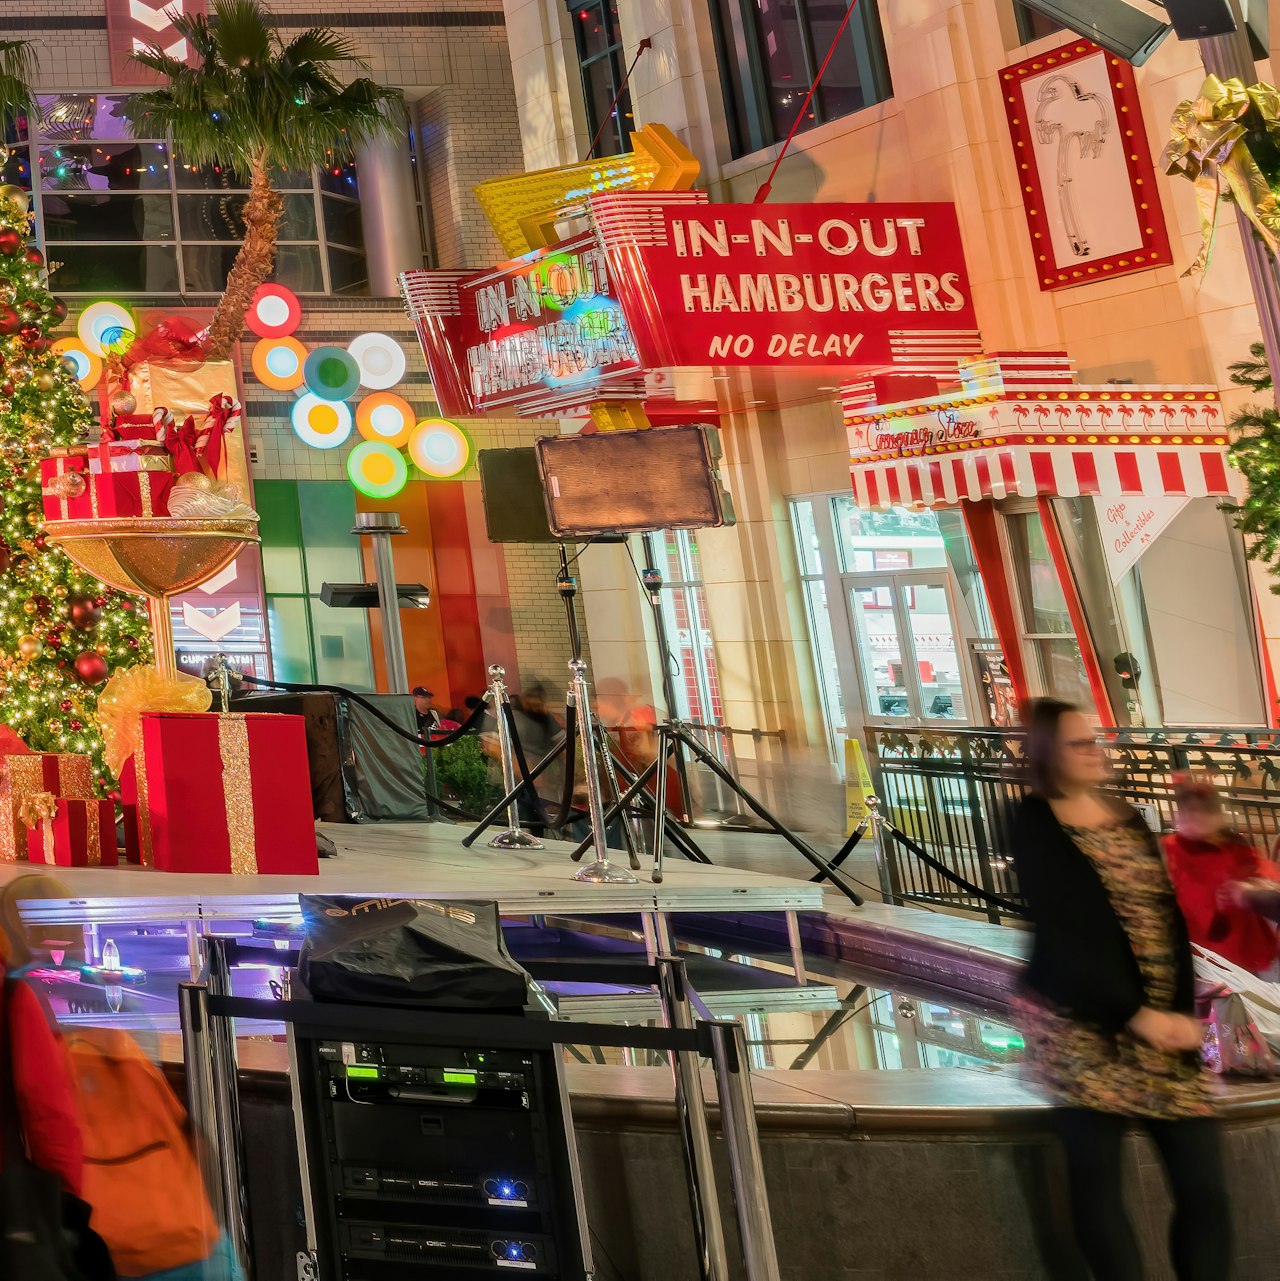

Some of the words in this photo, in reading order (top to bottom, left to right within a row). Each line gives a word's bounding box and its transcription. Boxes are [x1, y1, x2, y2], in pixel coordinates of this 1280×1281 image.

[673, 218, 925, 257] IN-N-OUT
[475, 249, 610, 333] IN-N-OUT
[679, 272, 966, 314] HAMBURGERS
[707, 334, 755, 358] NO
[767, 332, 864, 358] DELAY
[1106, 503, 1127, 524] Gifts
[1114, 509, 1155, 553] Collectibles
[418, 1179, 439, 1187] QSC
[426, 1239, 447, 1248] QSC
